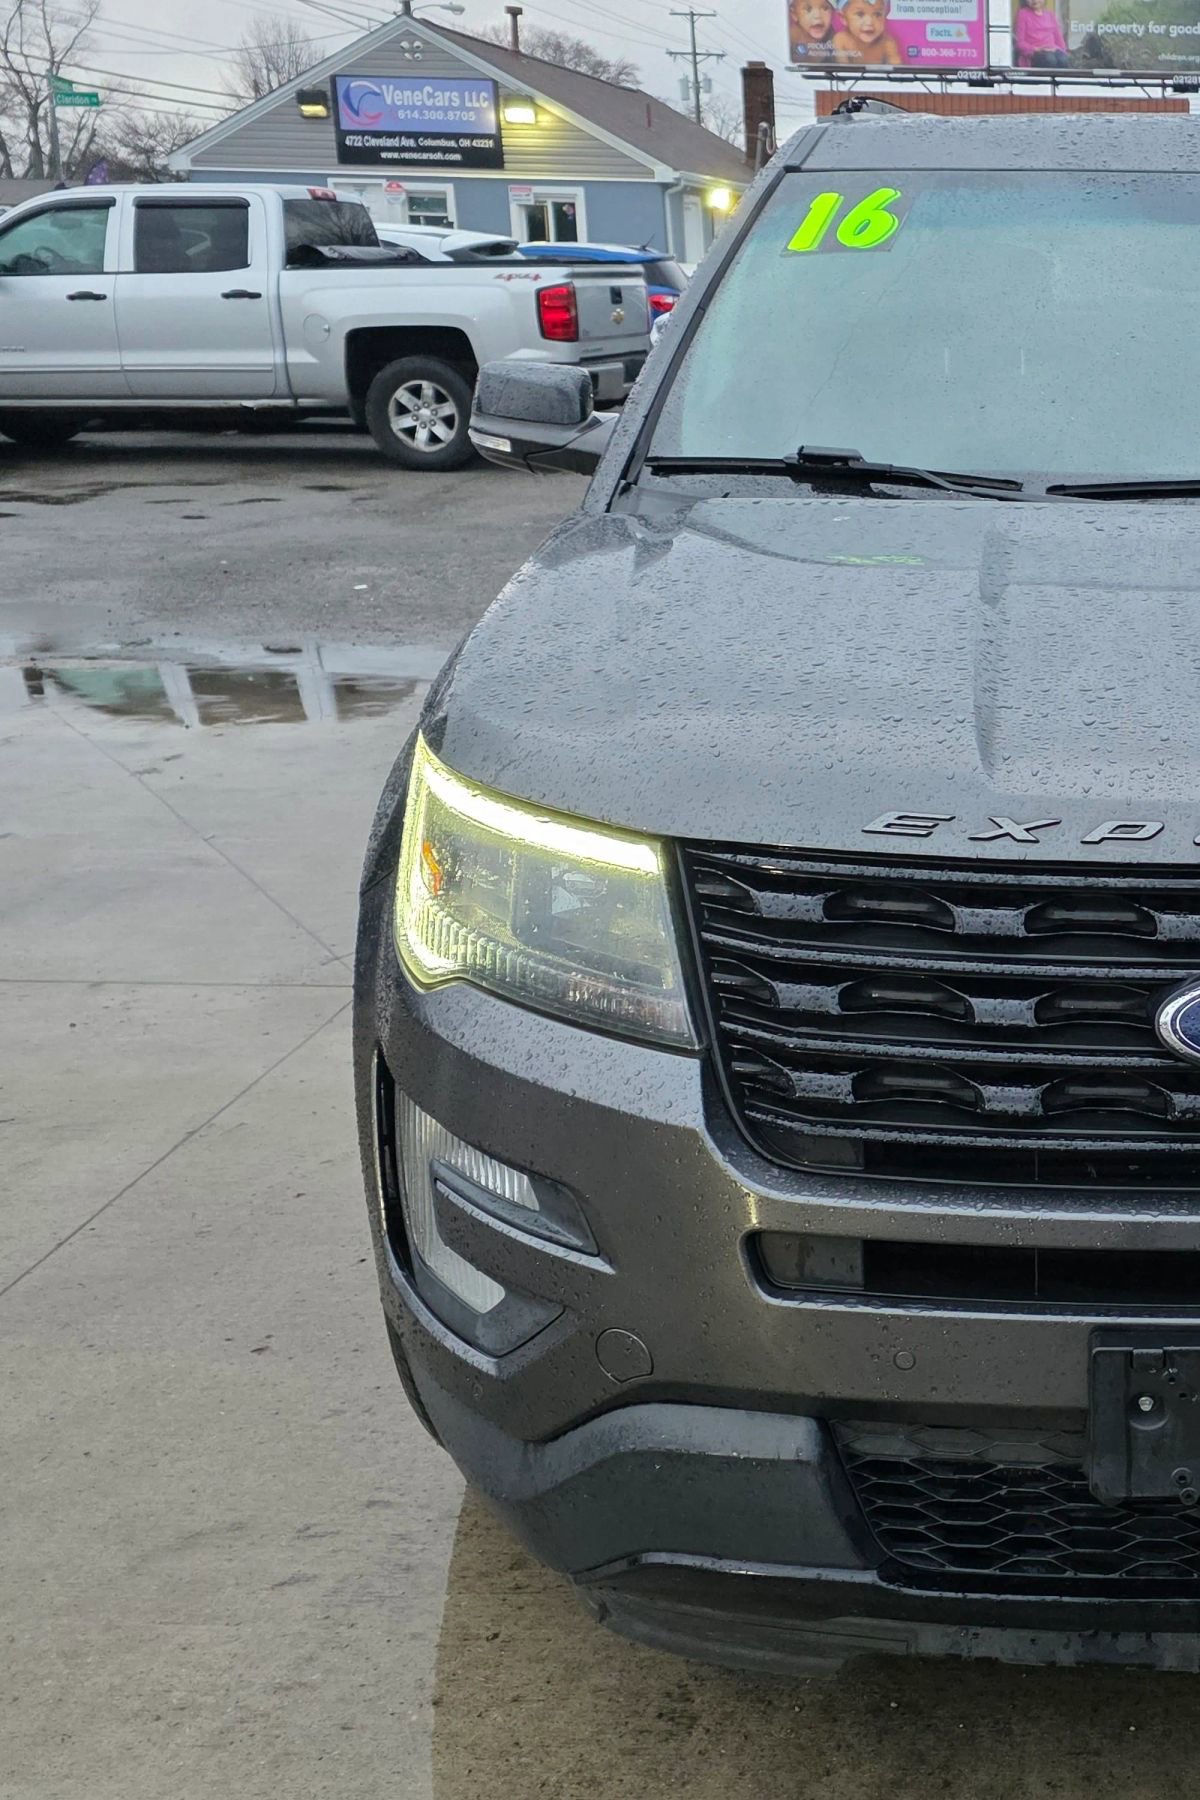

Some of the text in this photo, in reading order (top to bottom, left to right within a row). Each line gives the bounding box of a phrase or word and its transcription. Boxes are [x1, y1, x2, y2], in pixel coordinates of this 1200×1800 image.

[1070, 20, 1200, 38] End poverty for good
[382, 83, 489, 108] VeneCars LLC
[397, 109, 477, 121] 614.300.8705
[344, 135, 363, 147] 4722
[363, 135, 400, 148] Cleveland
[400, 135, 417, 148] Ave.
[417, 137, 458, 149] Columbus,
[458, 138, 471, 148] OH
[786, 187, 901, 252] 16
